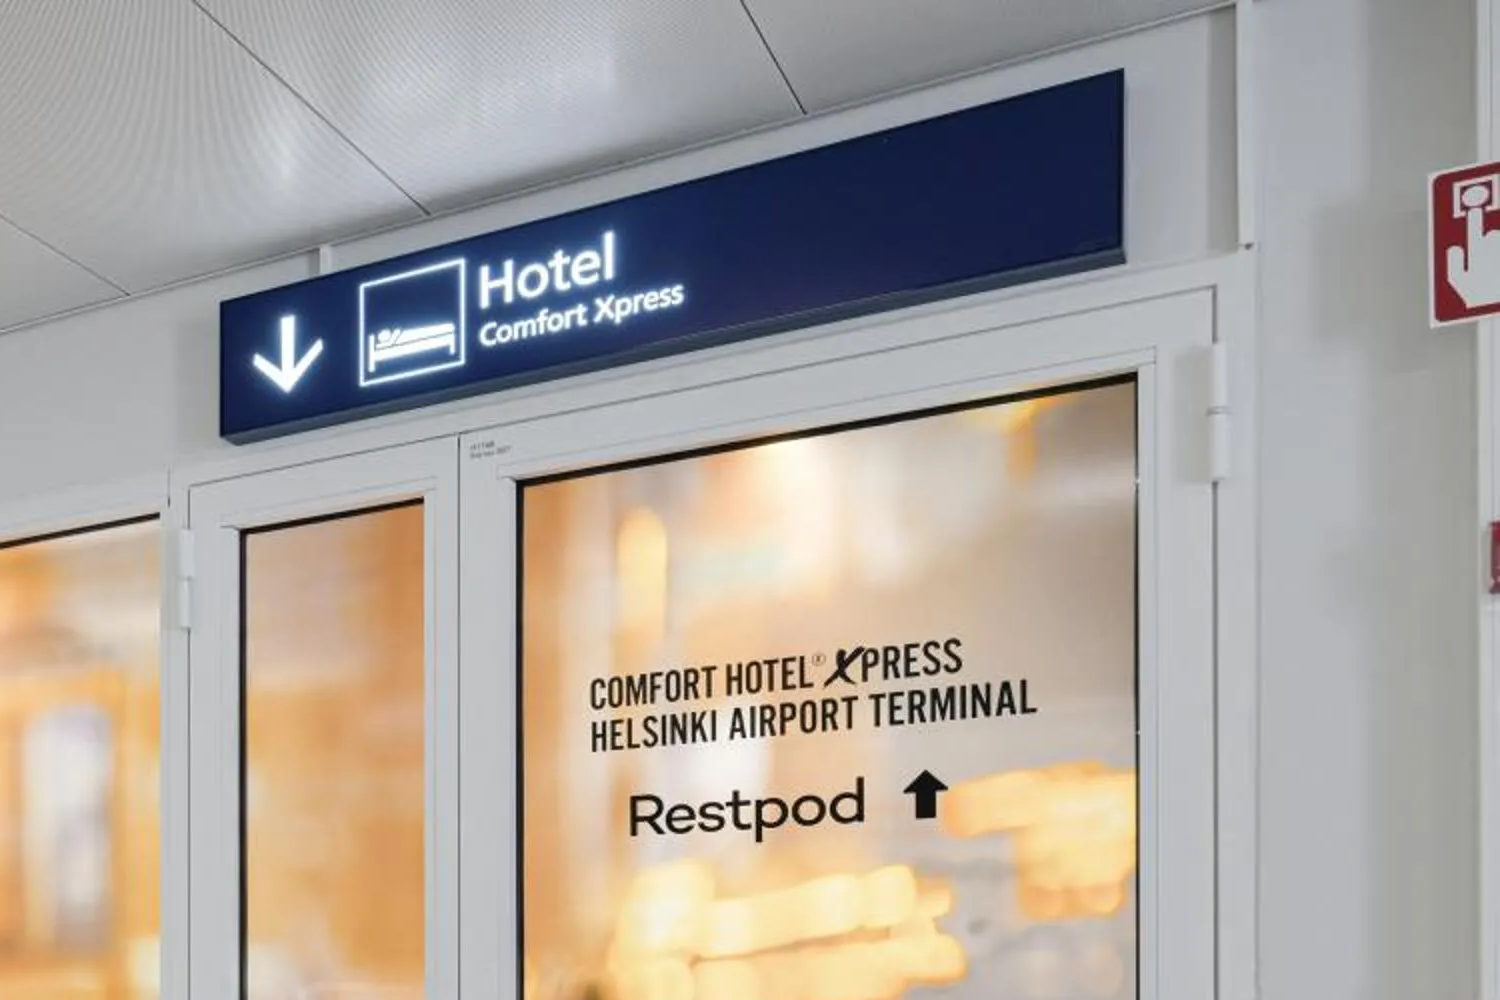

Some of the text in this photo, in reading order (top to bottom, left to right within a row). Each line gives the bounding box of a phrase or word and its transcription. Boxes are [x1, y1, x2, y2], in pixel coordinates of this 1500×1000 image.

[478, 231, 616, 309] Hotel
[479, 283, 685, 347] Comfort Xpress
[590, 665, 717, 710] COMFORT
[823, 637, 963, 688] XPRESS
[591, 679, 1038, 753] HELSINKI AIRPORT TERMINAL
[629, 776, 865, 843] Restpod
